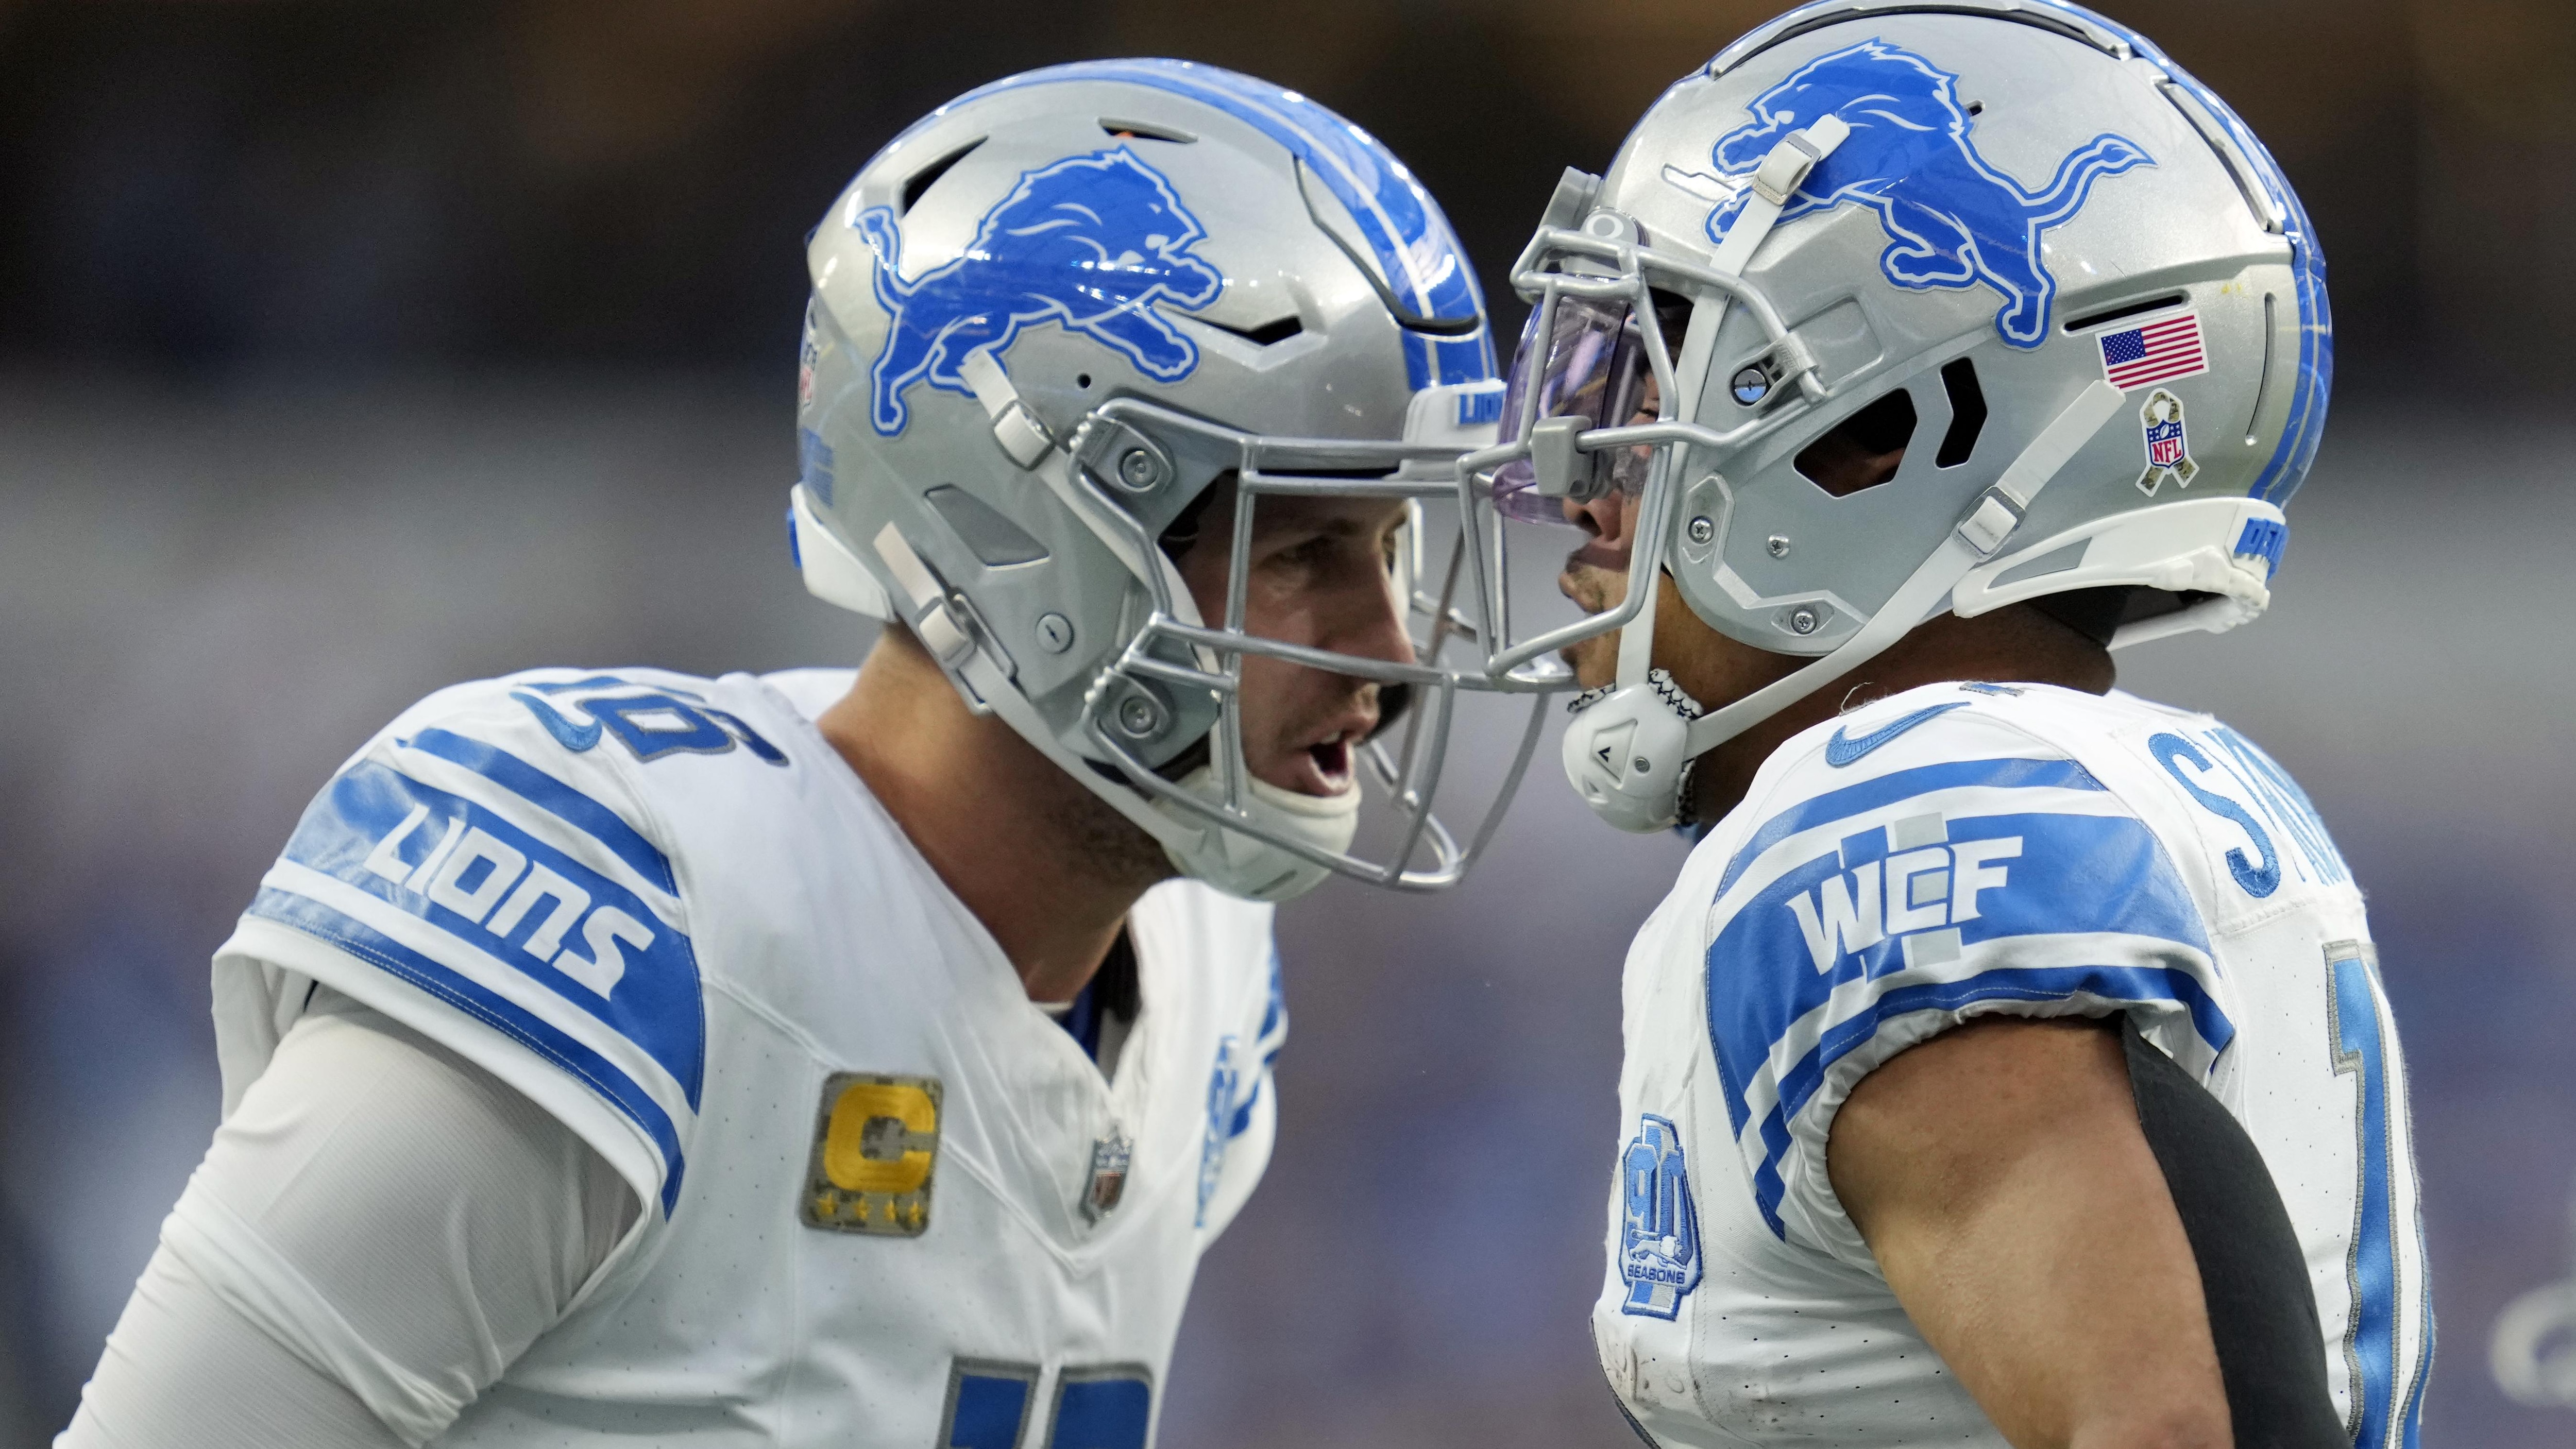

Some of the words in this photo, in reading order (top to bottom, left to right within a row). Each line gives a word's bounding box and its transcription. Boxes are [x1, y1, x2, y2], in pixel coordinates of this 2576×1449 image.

[2152, 439, 2182, 463] NFL
[363, 804, 655, 1002] LIONS
[1786, 836, 2023, 976] WCF
[824, 1083, 936, 1194] C
[1628, 1264, 1686, 1284] SEASONS
